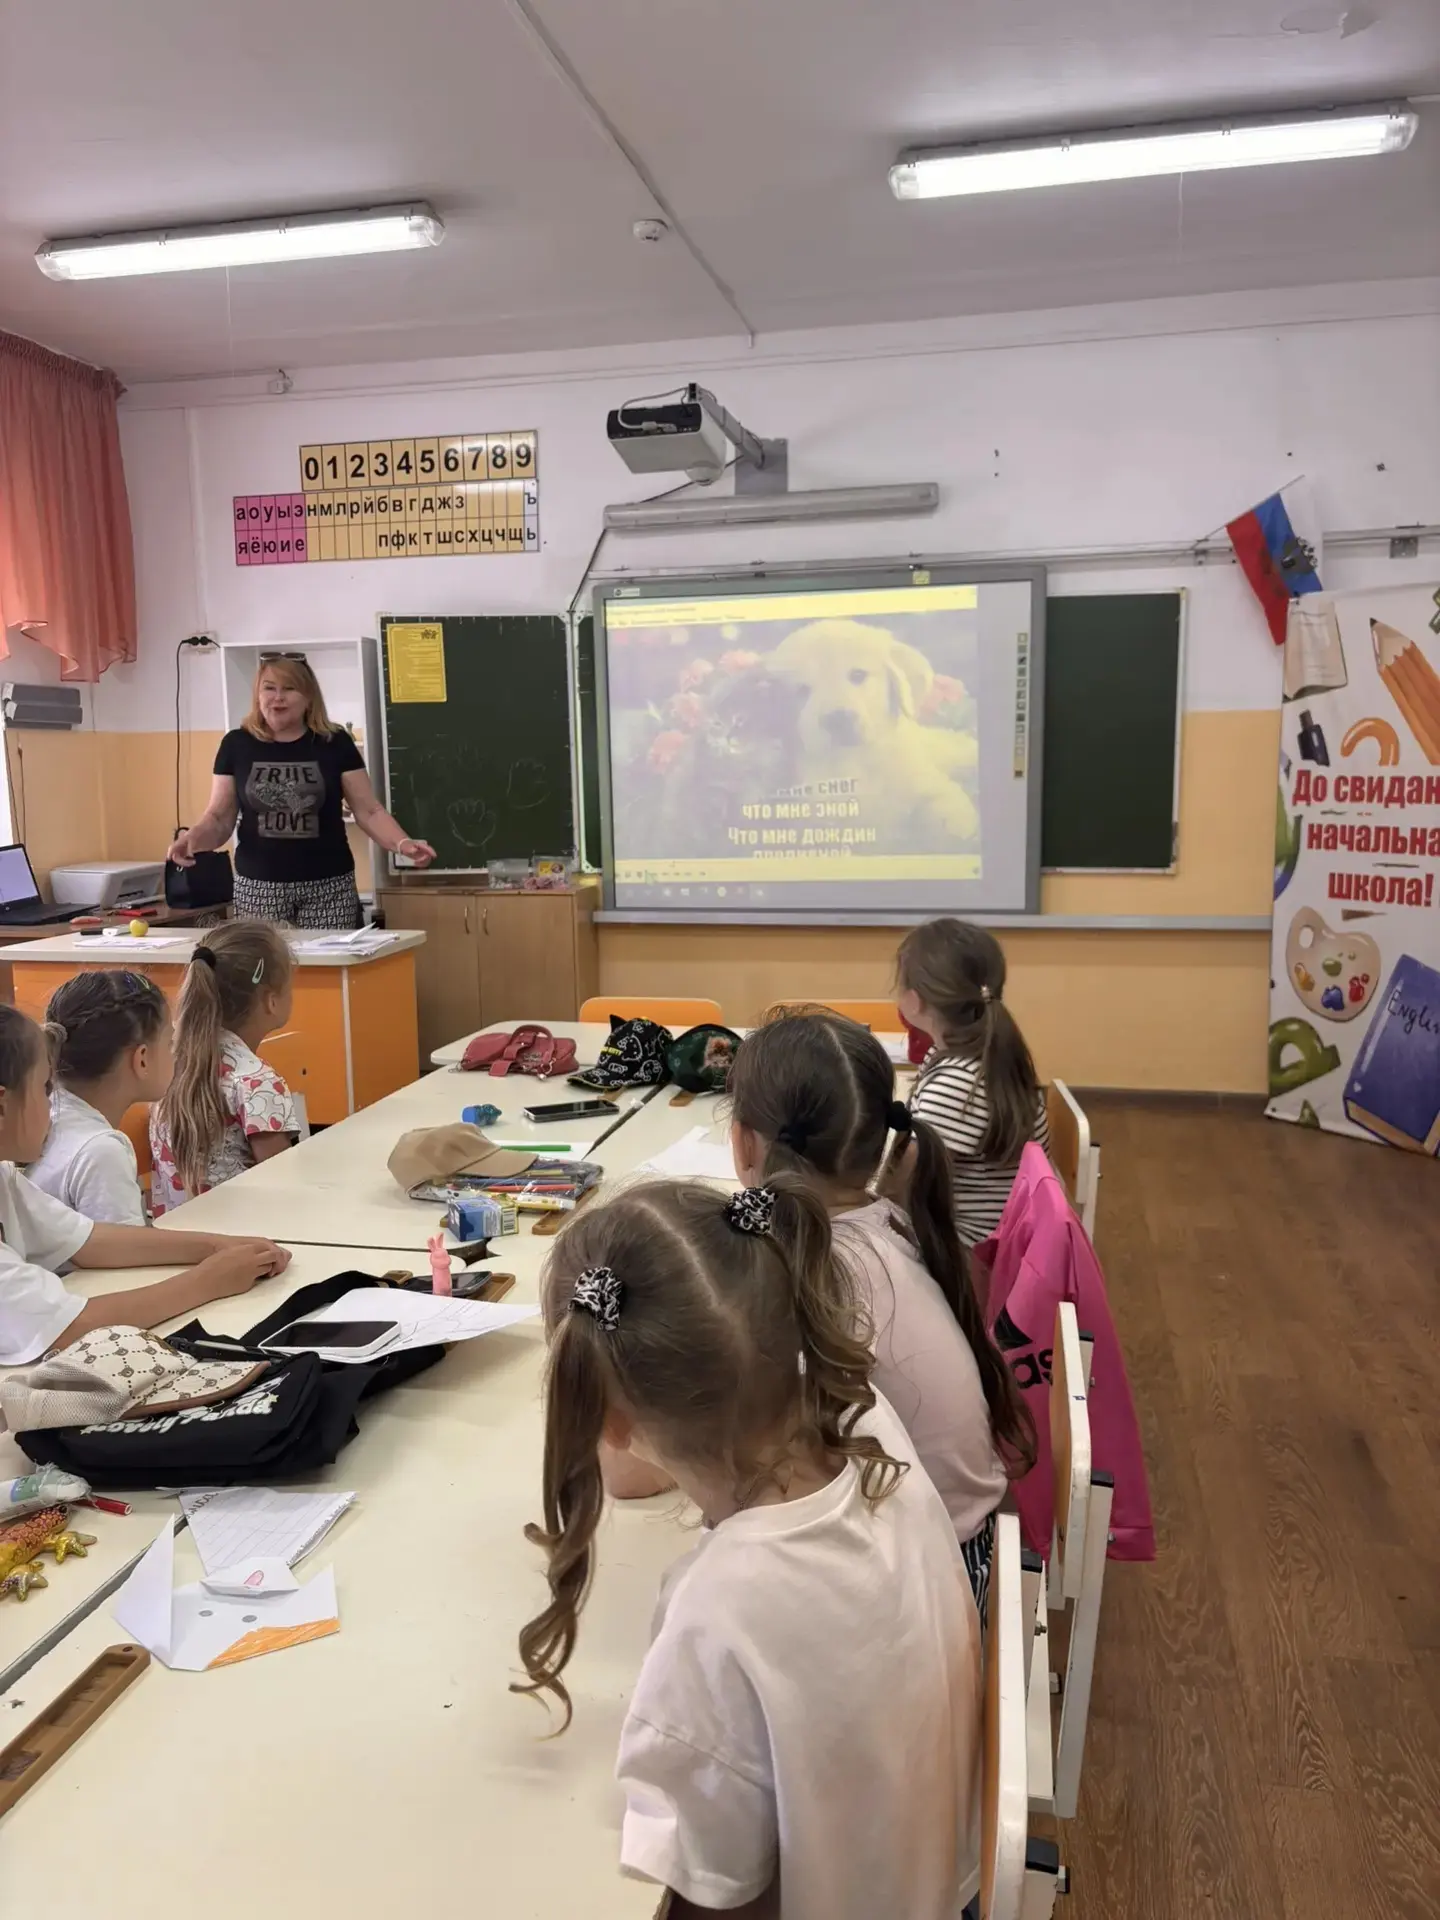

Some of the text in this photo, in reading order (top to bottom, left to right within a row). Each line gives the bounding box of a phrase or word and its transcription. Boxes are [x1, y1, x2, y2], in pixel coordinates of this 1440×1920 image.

[254, 767, 318, 785] TRUE
[1292, 769, 1440, 808] До свидан
[264, 811, 313, 831] LOVE
[1307, 823, 1440, 857] начальна
[1328, 872, 1434, 907] школа!
